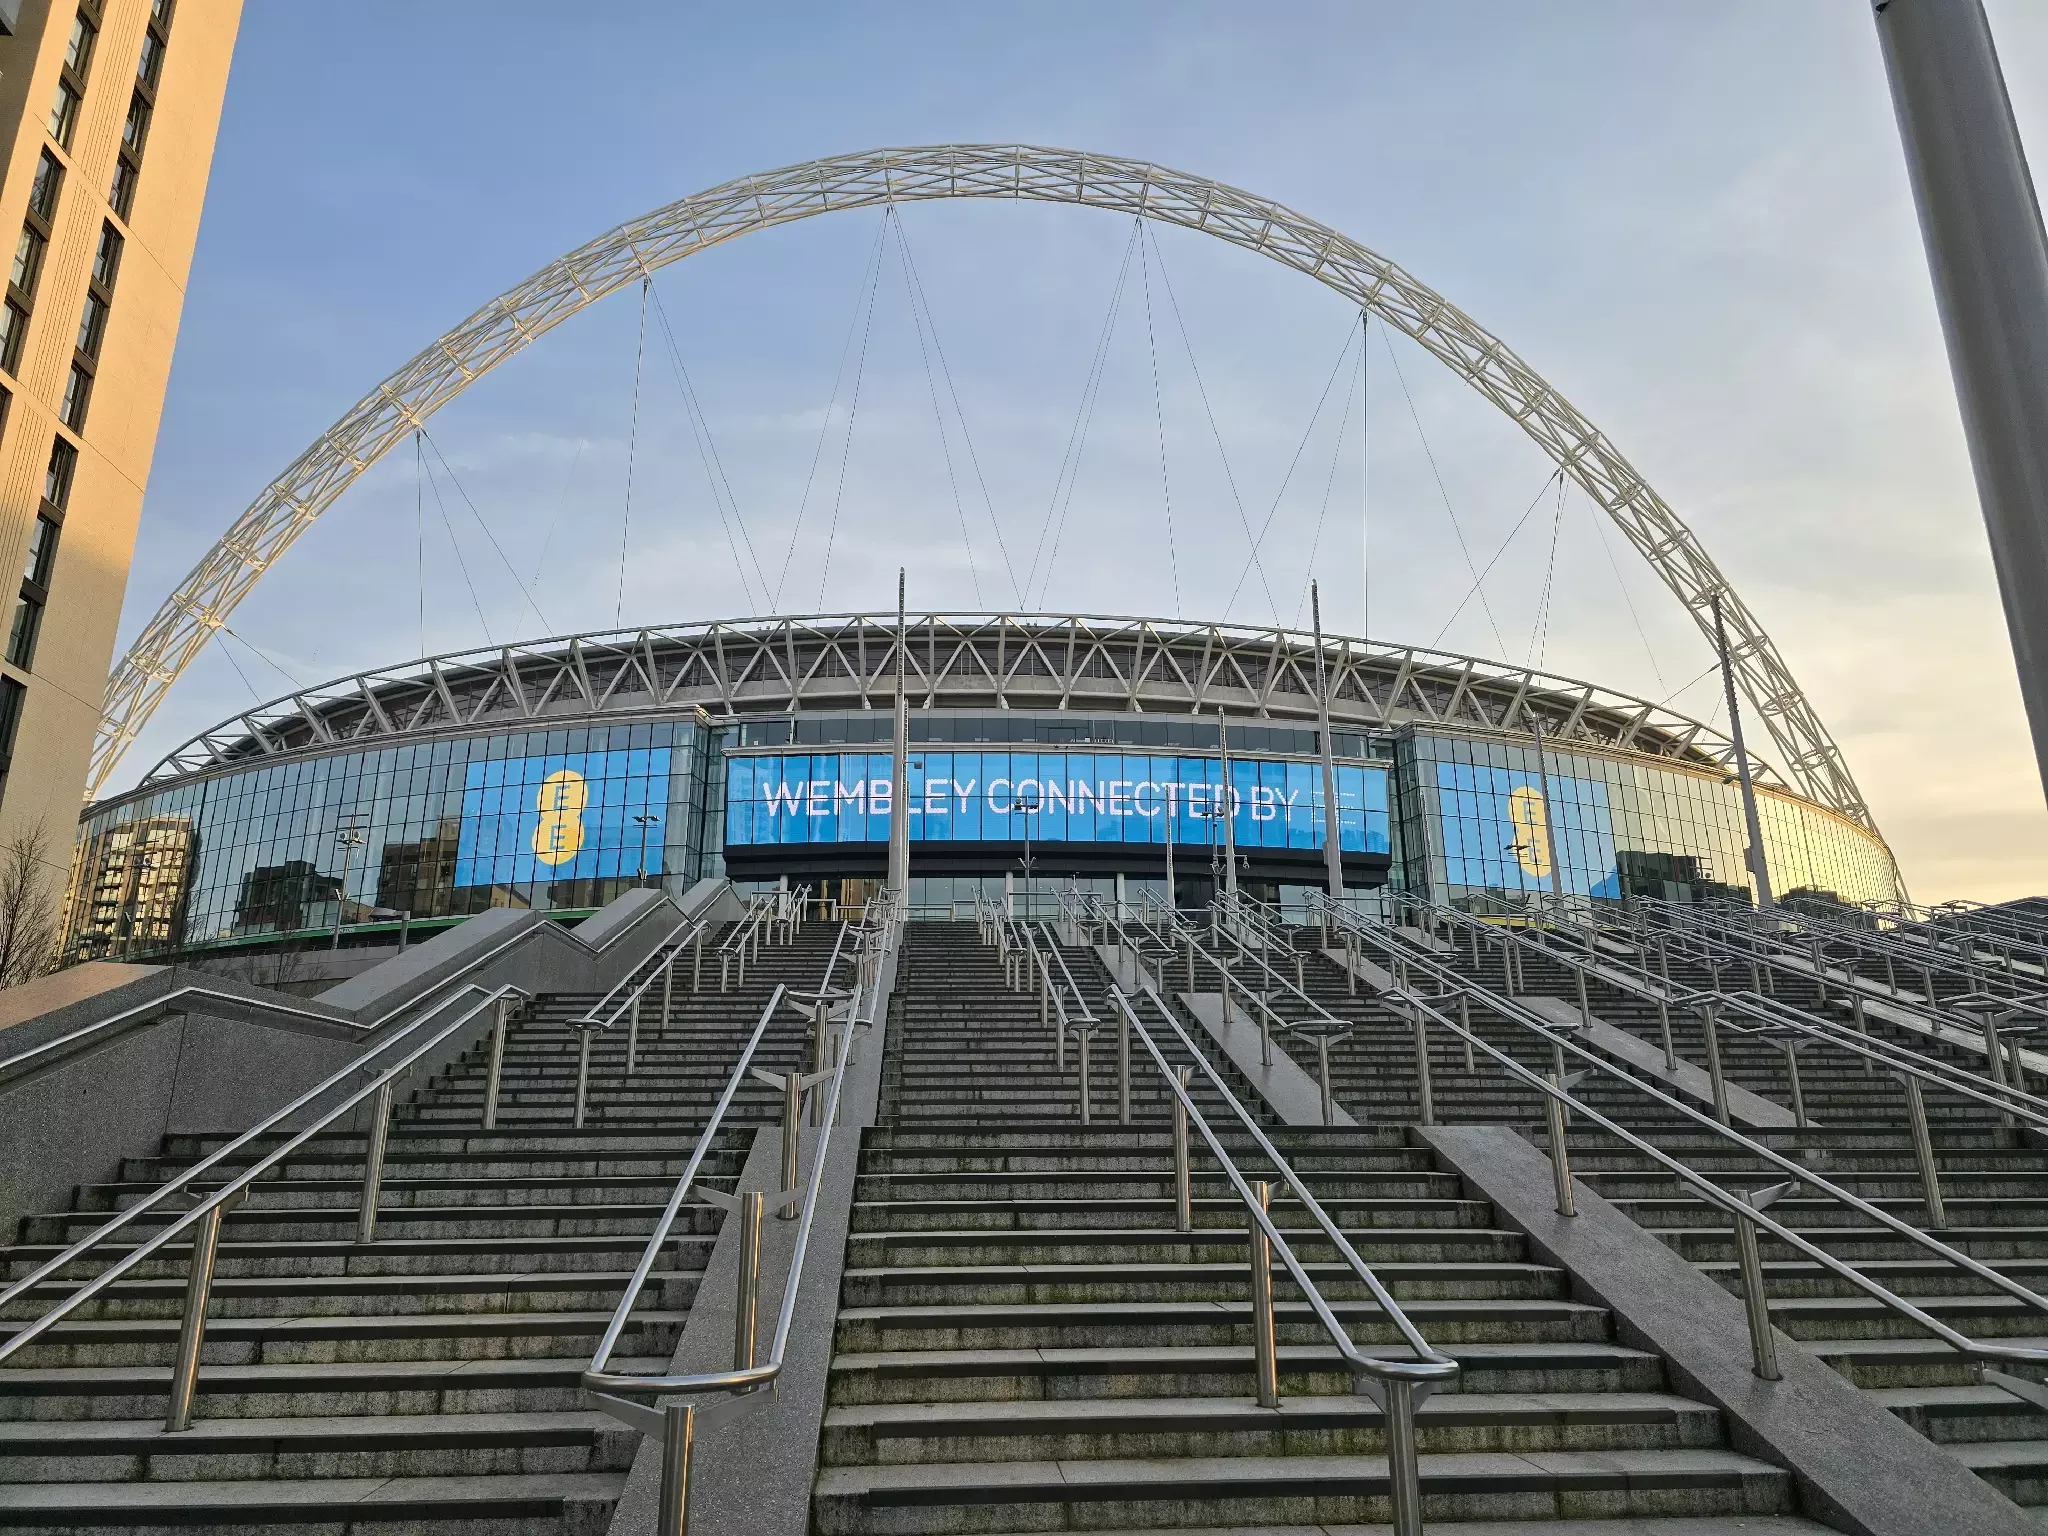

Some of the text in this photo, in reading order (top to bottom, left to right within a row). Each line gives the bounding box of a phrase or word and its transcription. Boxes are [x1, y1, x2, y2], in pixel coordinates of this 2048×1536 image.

[763, 778, 976, 817] WEMBEY
[987, 778, 1240, 819] CONNECTED
[1251, 785, 1299, 823] BY
